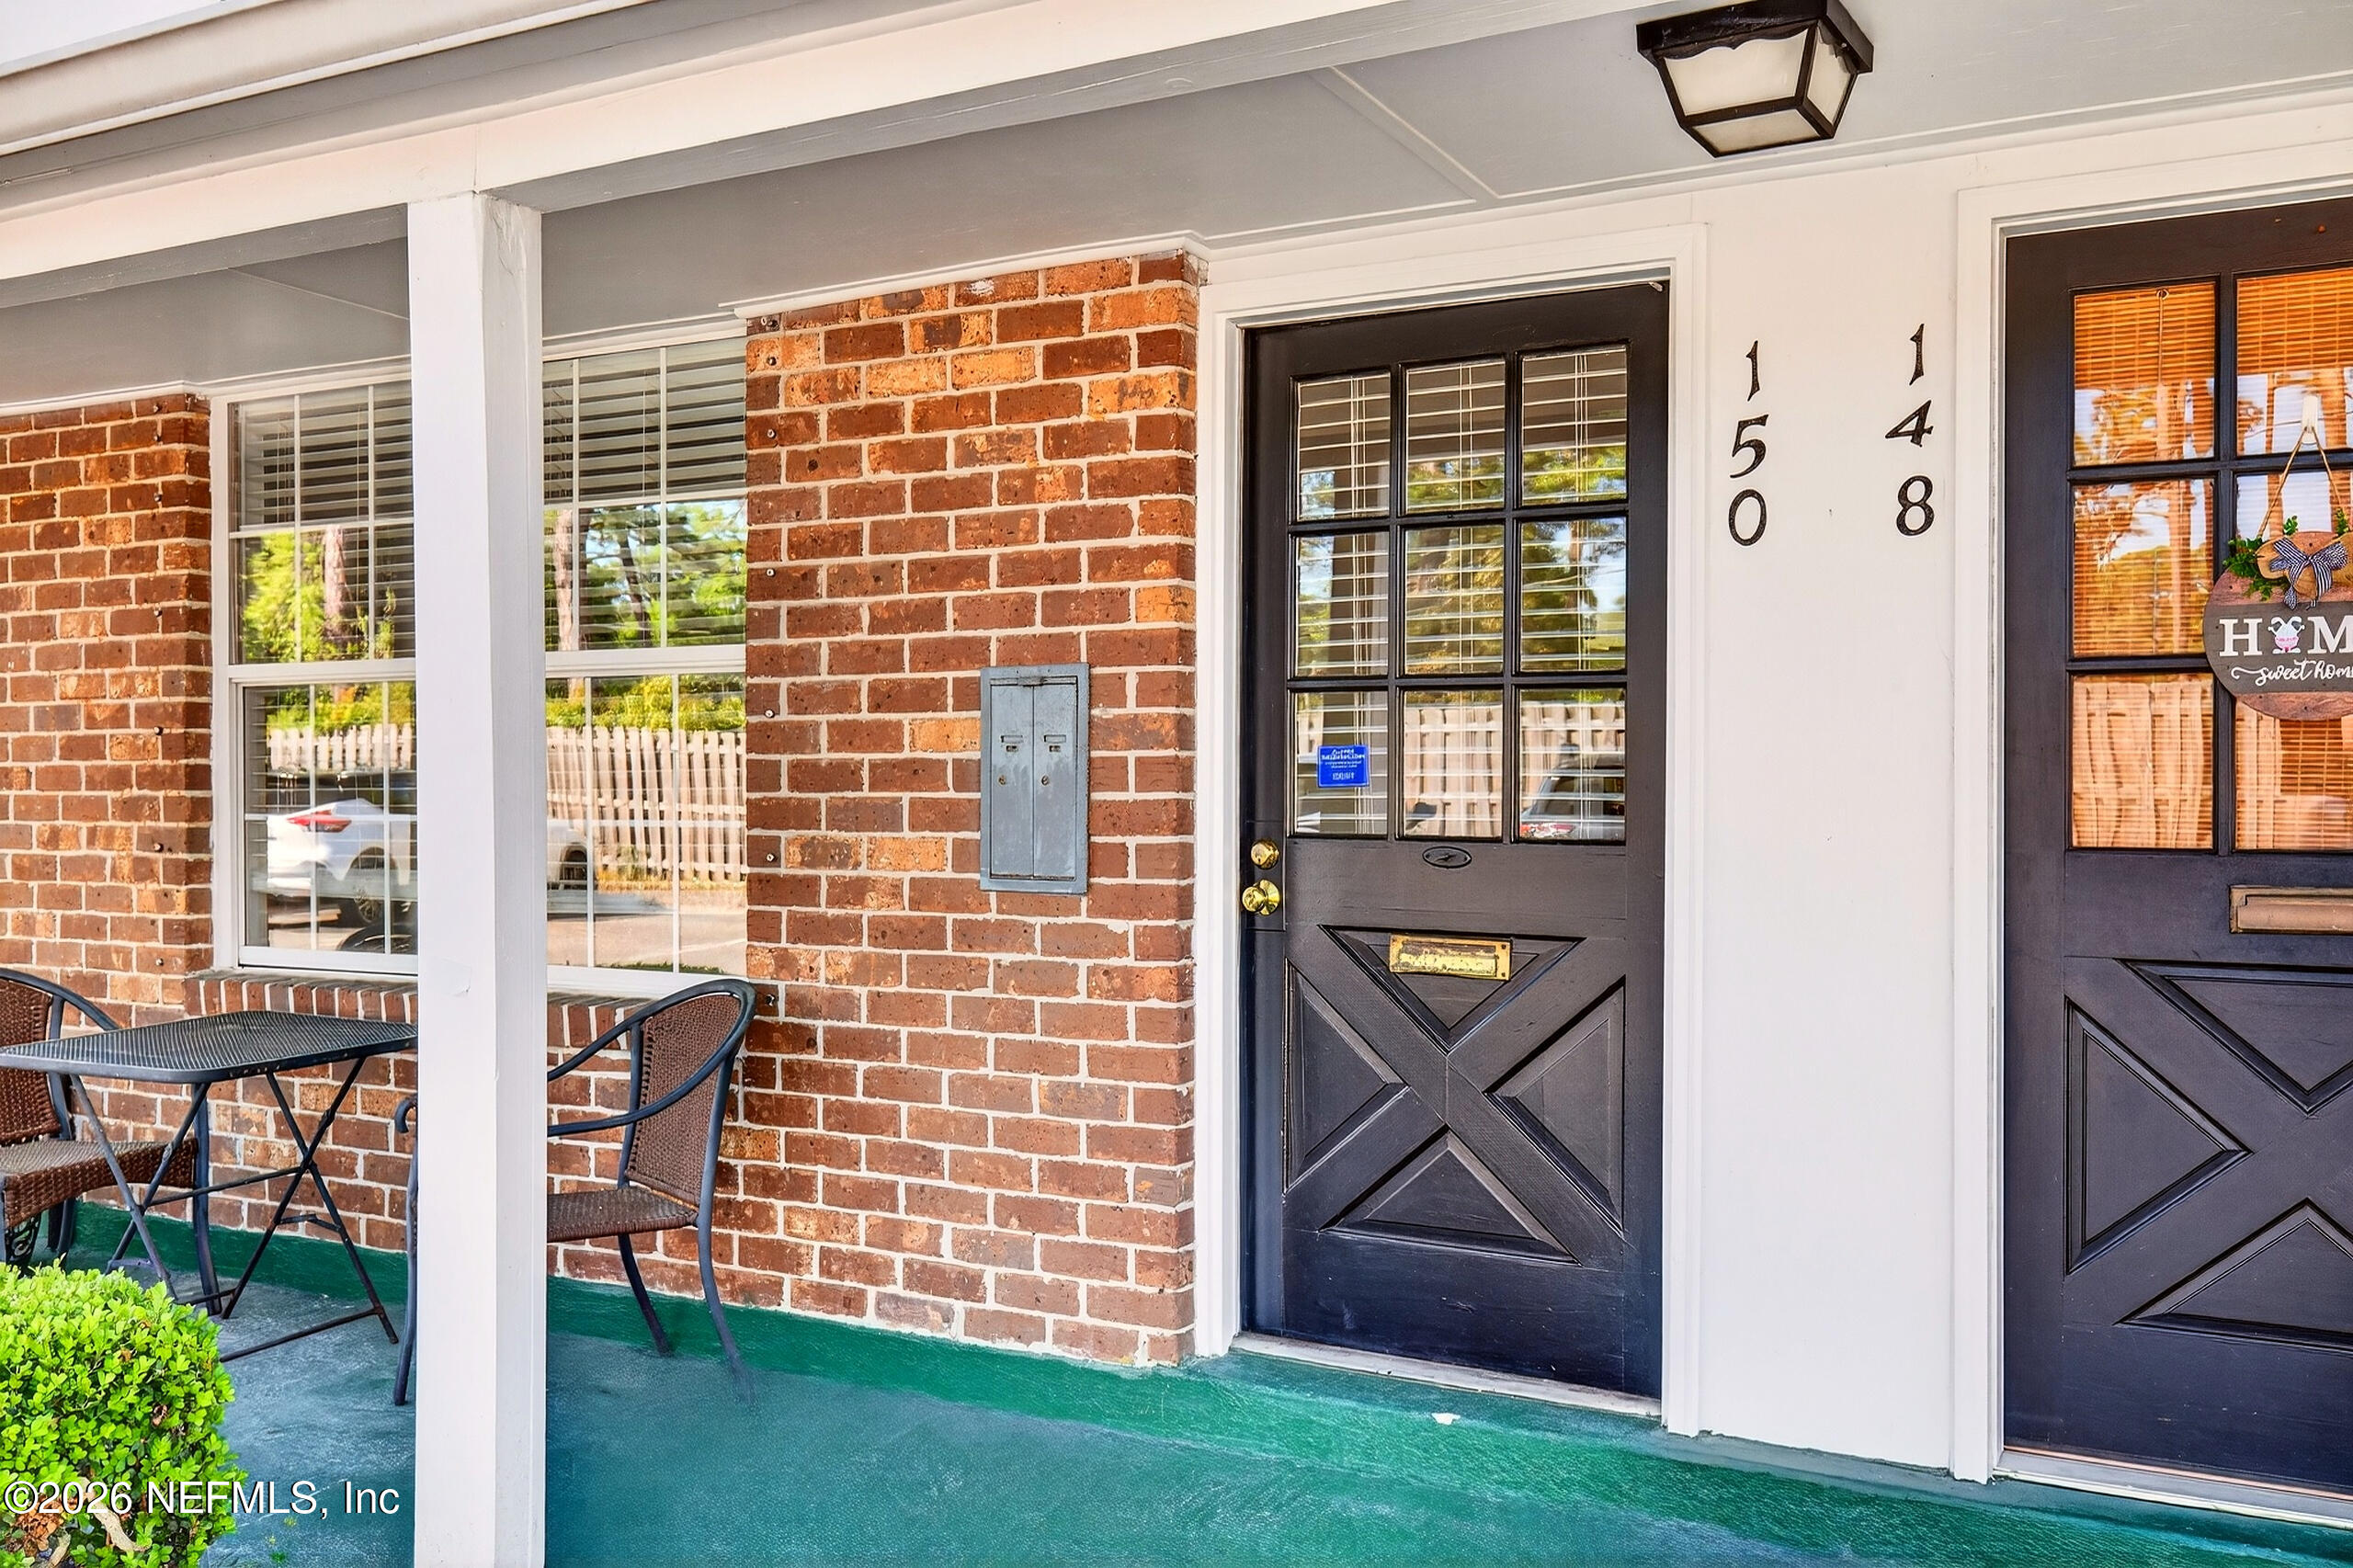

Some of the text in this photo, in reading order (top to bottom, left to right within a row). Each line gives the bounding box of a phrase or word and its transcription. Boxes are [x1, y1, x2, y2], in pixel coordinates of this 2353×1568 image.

[1728, 340, 1769, 546] 150
[1885, 324, 1934, 536] 148
[2231, 657, 2353, 687] sweet hom
